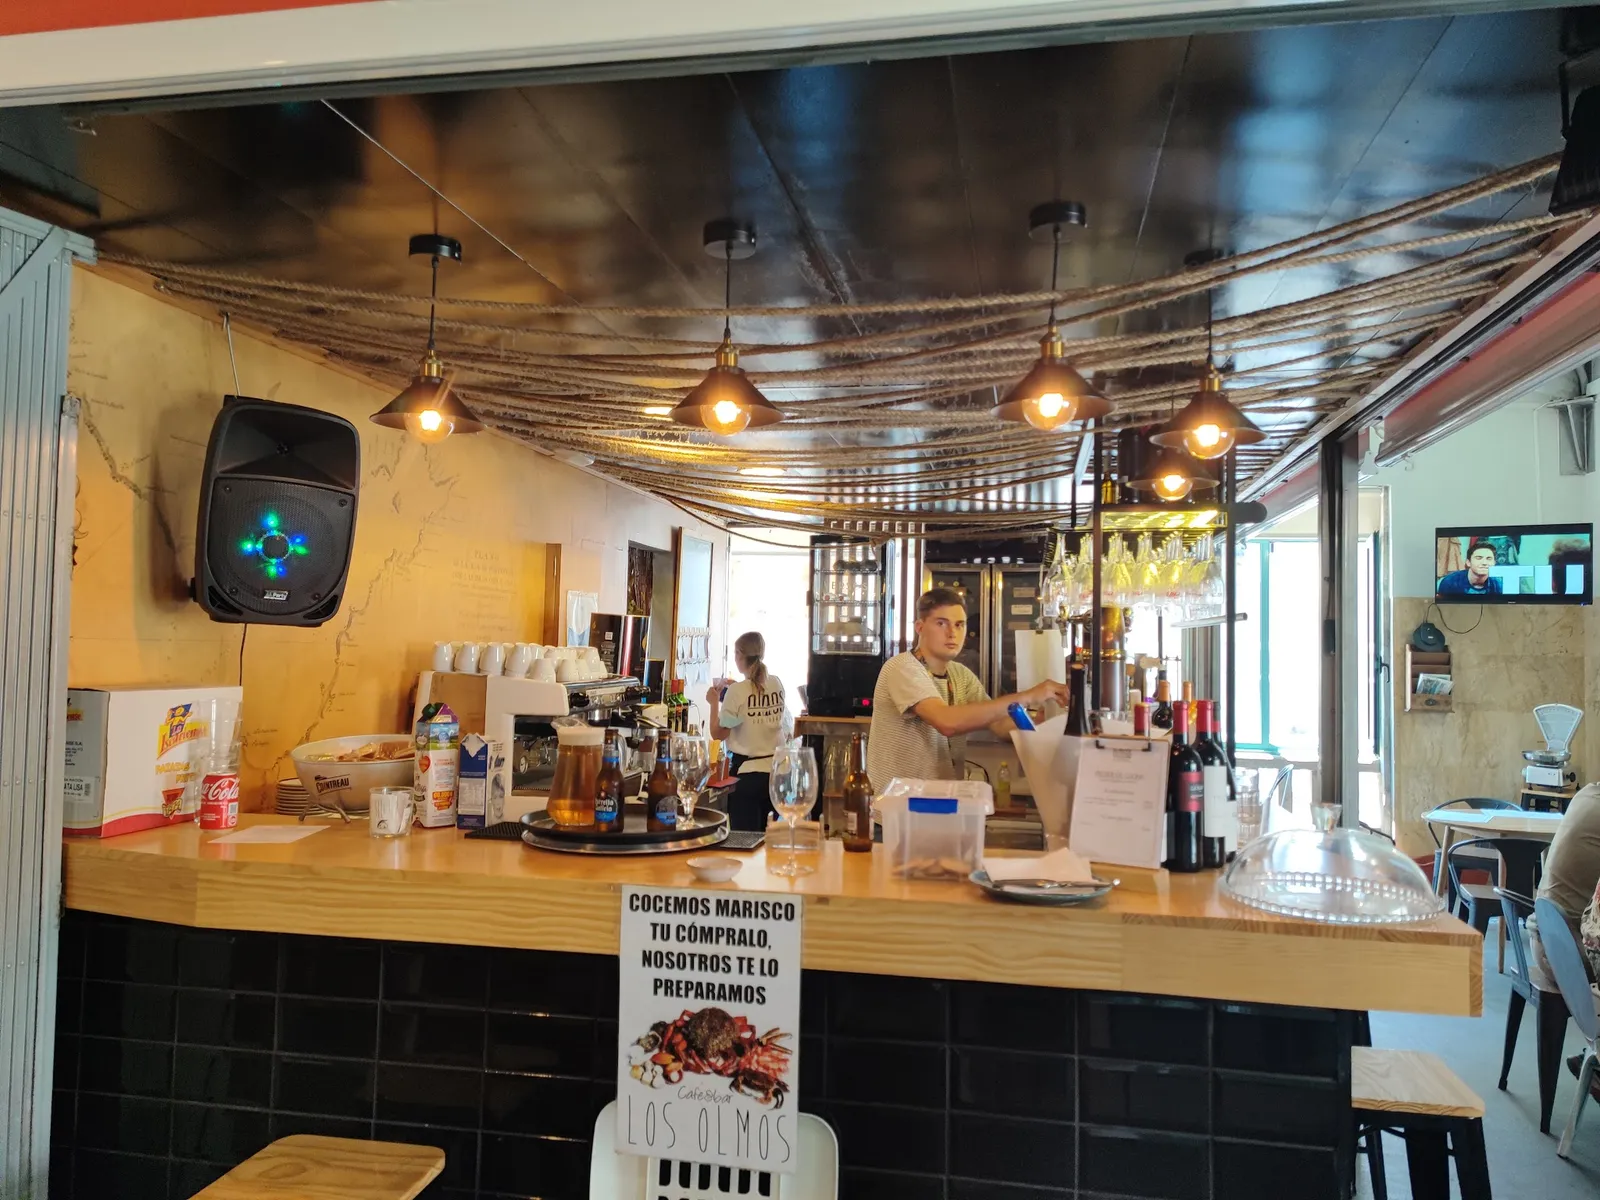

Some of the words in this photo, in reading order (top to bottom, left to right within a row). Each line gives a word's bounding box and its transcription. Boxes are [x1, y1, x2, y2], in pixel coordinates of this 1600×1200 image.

[315, 777, 350, 794] COINTREAU
[629, 893, 711, 917] COCEMOS
[715, 898, 796, 922] MARISCO
[650, 922, 672, 942] TU
[675, 921, 772, 950] CÓMPRALO,
[642, 949, 732, 974] NOSOTROS
[736, 956, 755, 977] TE
[759, 957, 779, 977] LO
[653, 977, 767, 1005] PREPARAMOS
[628, 1094, 677, 1150] LOS
[698, 1104, 791, 1164] OLMOS
